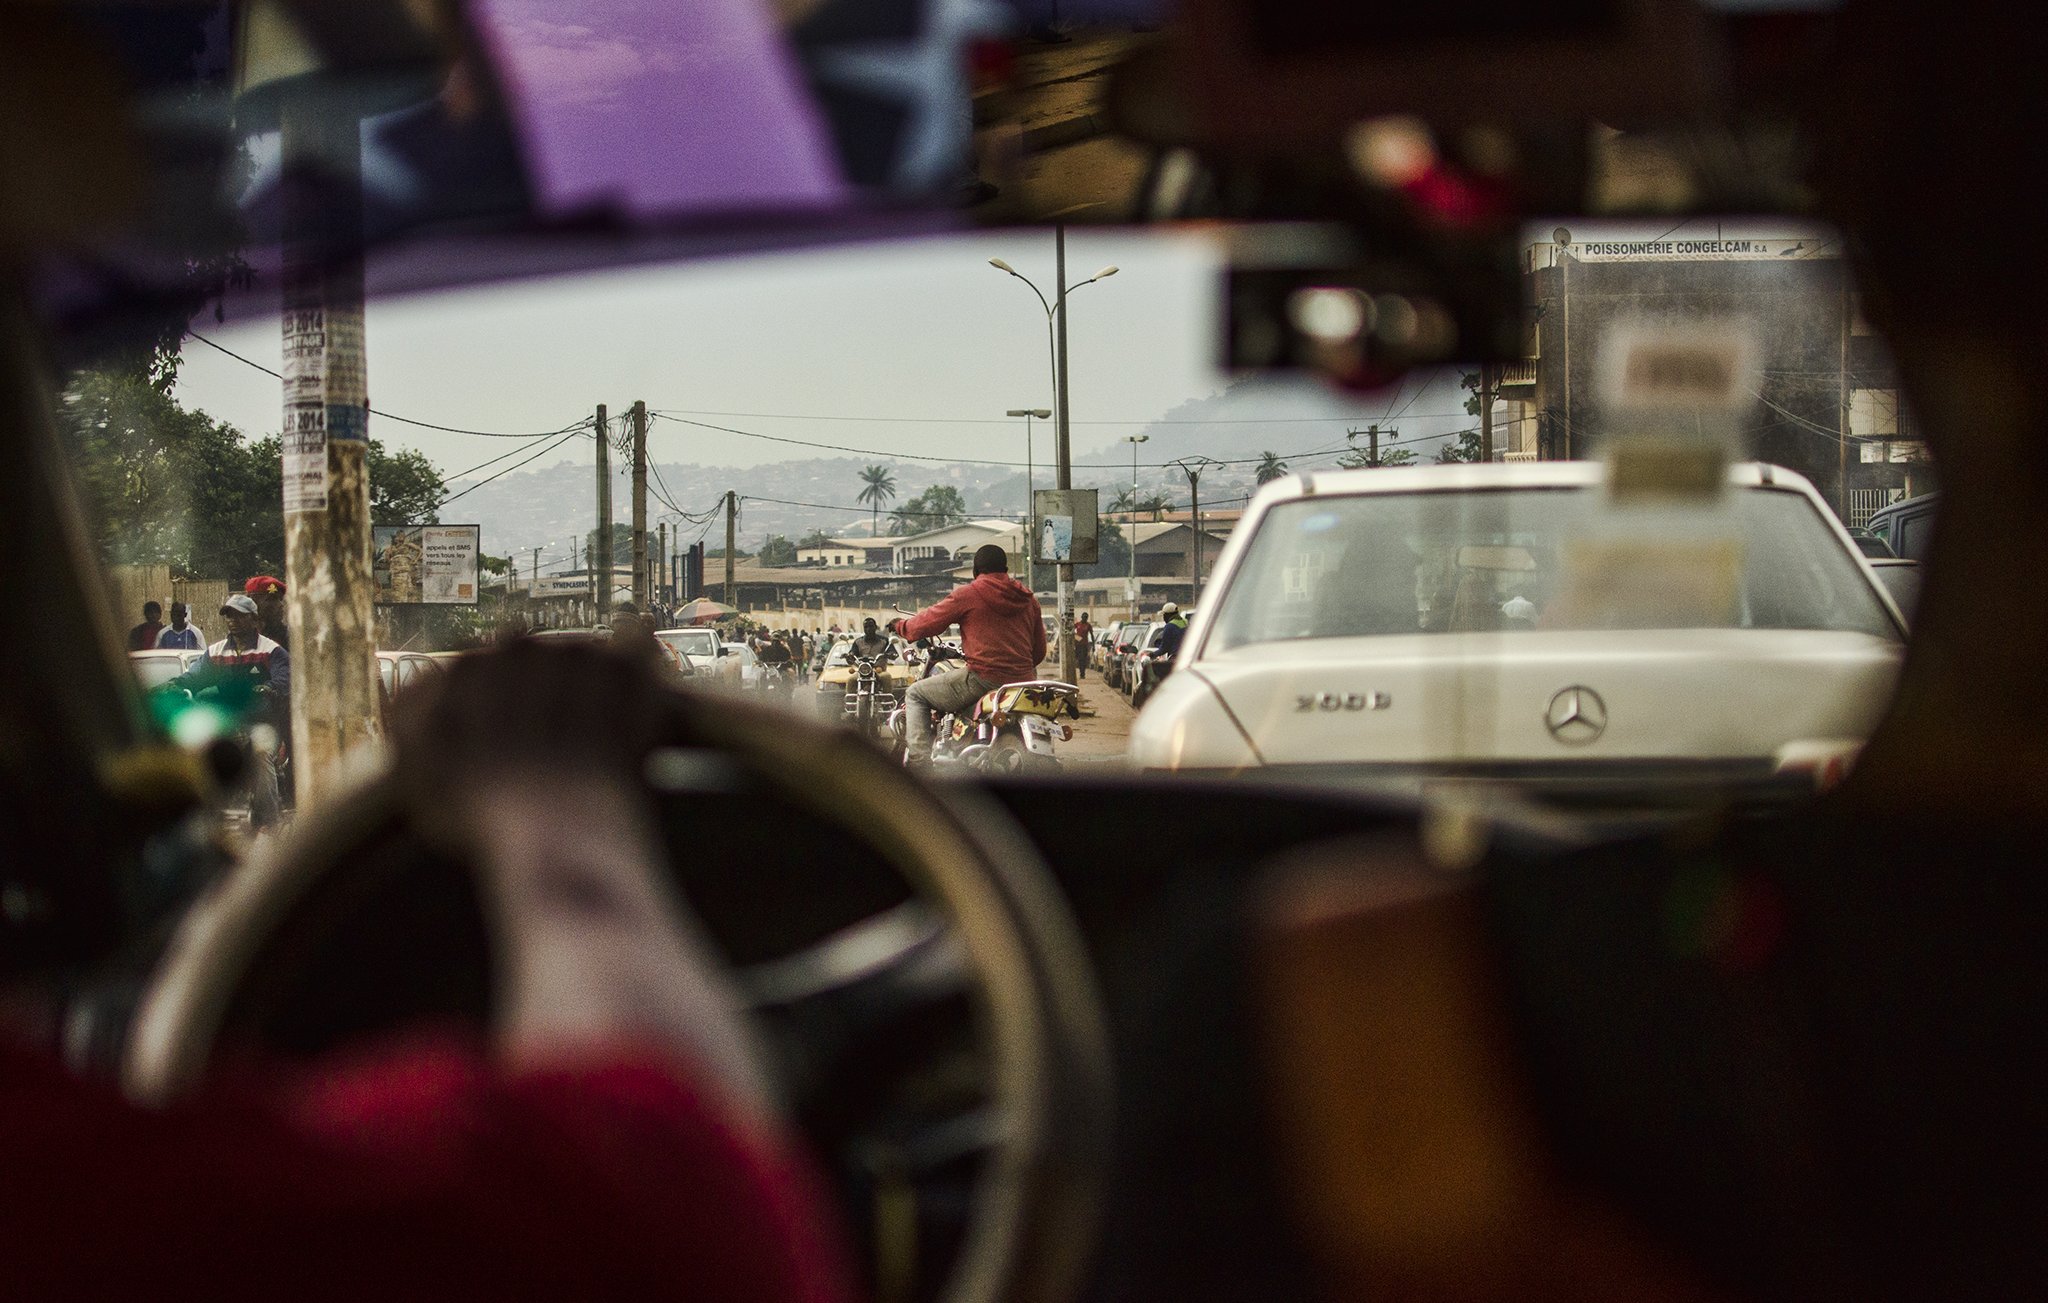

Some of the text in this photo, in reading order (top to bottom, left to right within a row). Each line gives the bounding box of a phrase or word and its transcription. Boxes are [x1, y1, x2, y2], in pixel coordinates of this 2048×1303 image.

[1585, 243, 1673, 255] POISSONNERIE
[1676, 242, 1751, 254] CONGELCAM
[296, 311, 323, 332] 2014
[298, 410, 324, 430] 2014
